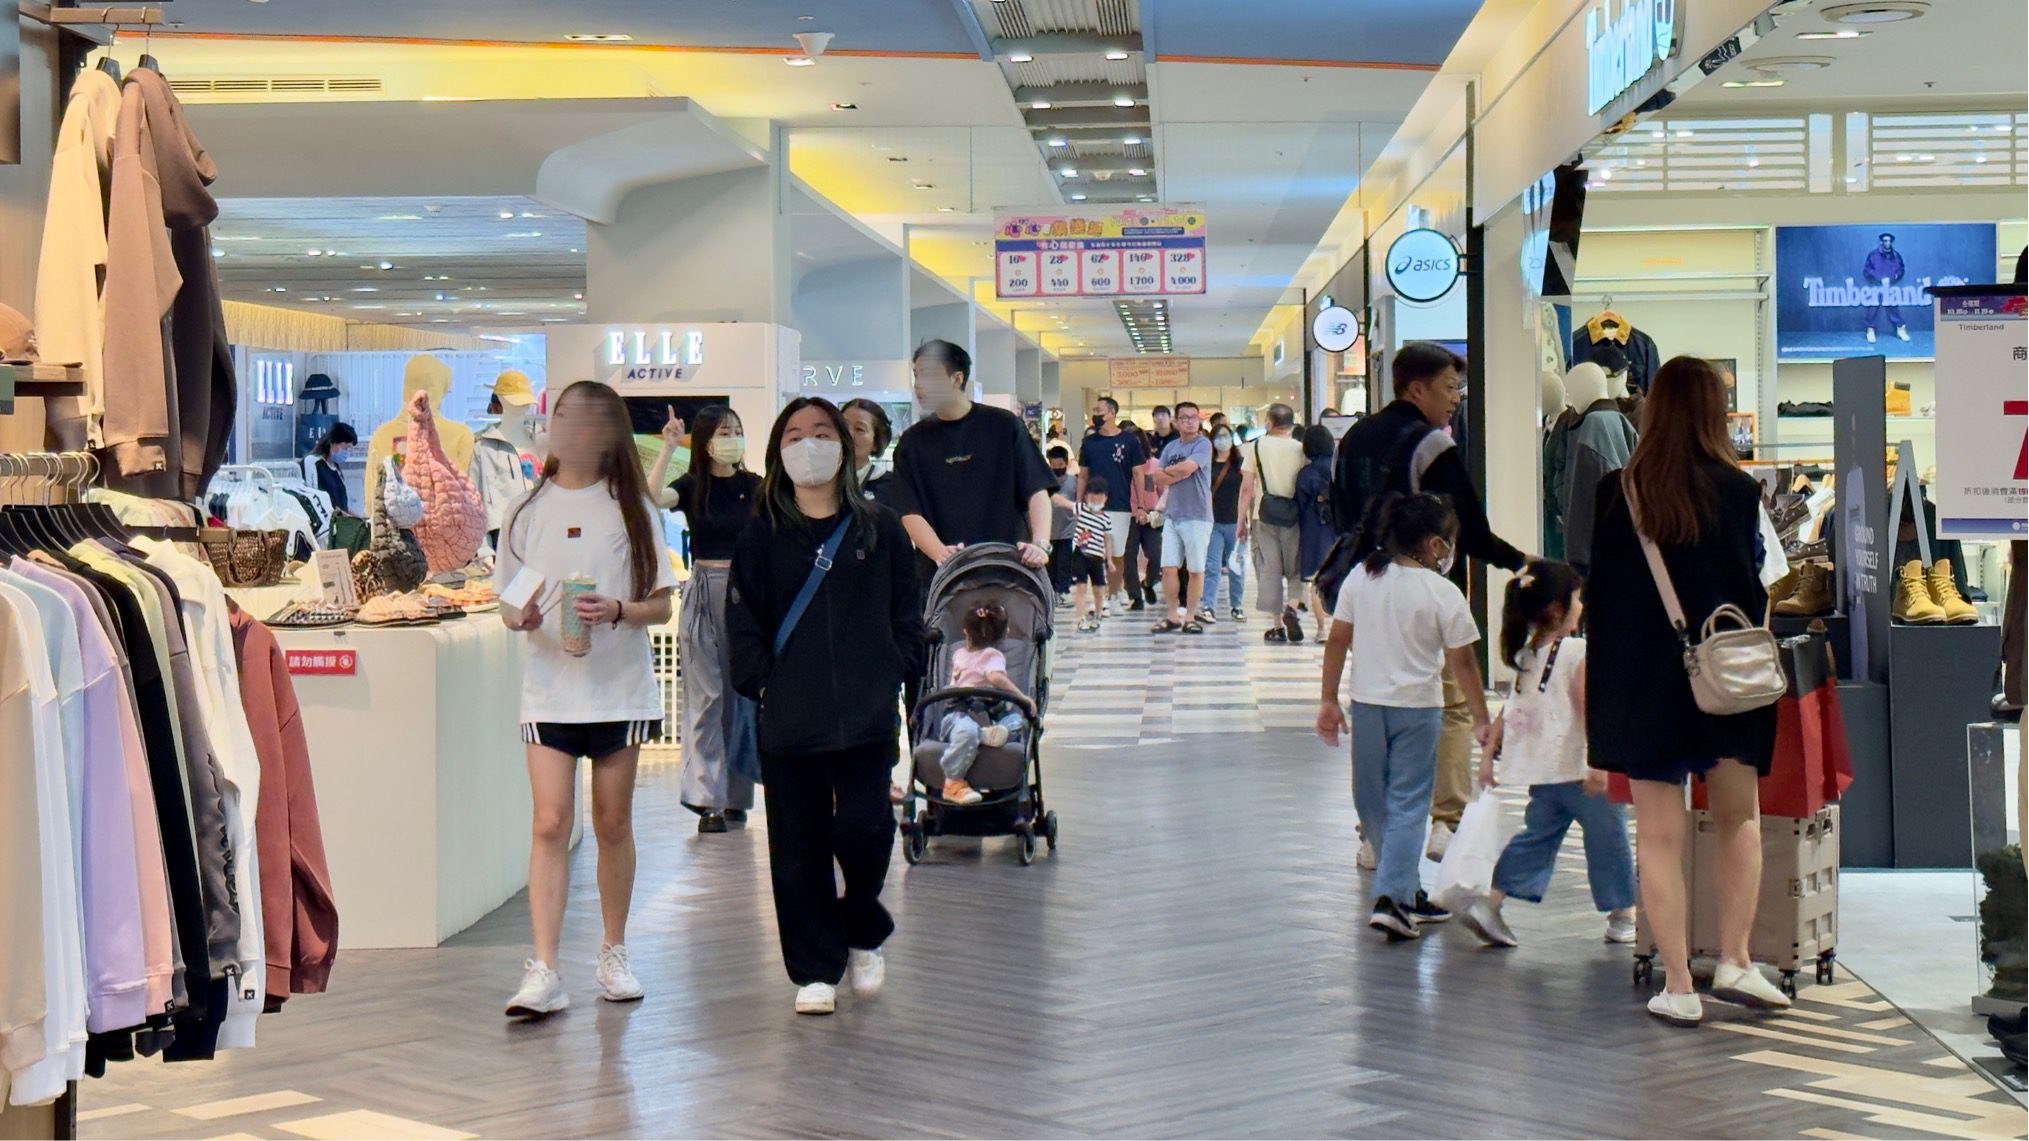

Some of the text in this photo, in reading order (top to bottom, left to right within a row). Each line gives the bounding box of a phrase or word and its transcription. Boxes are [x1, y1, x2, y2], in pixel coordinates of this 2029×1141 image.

[1413, 258, 1451, 272] asics
[1091, 277, 1111, 287] 600
[1803, 276, 1933, 307] Timberland
[1958, 323, 2005, 331] Timberland
[608, 331, 703, 365] ELLE
[627, 368, 683, 379] ACTIVE
[1855, 525, 1874, 545] GROUND
[1855, 549, 1879, 570] YOURSELF
[1860, 574, 1877, 593] TRUTH
[288, 655, 337, 668] 請勿觸摸
